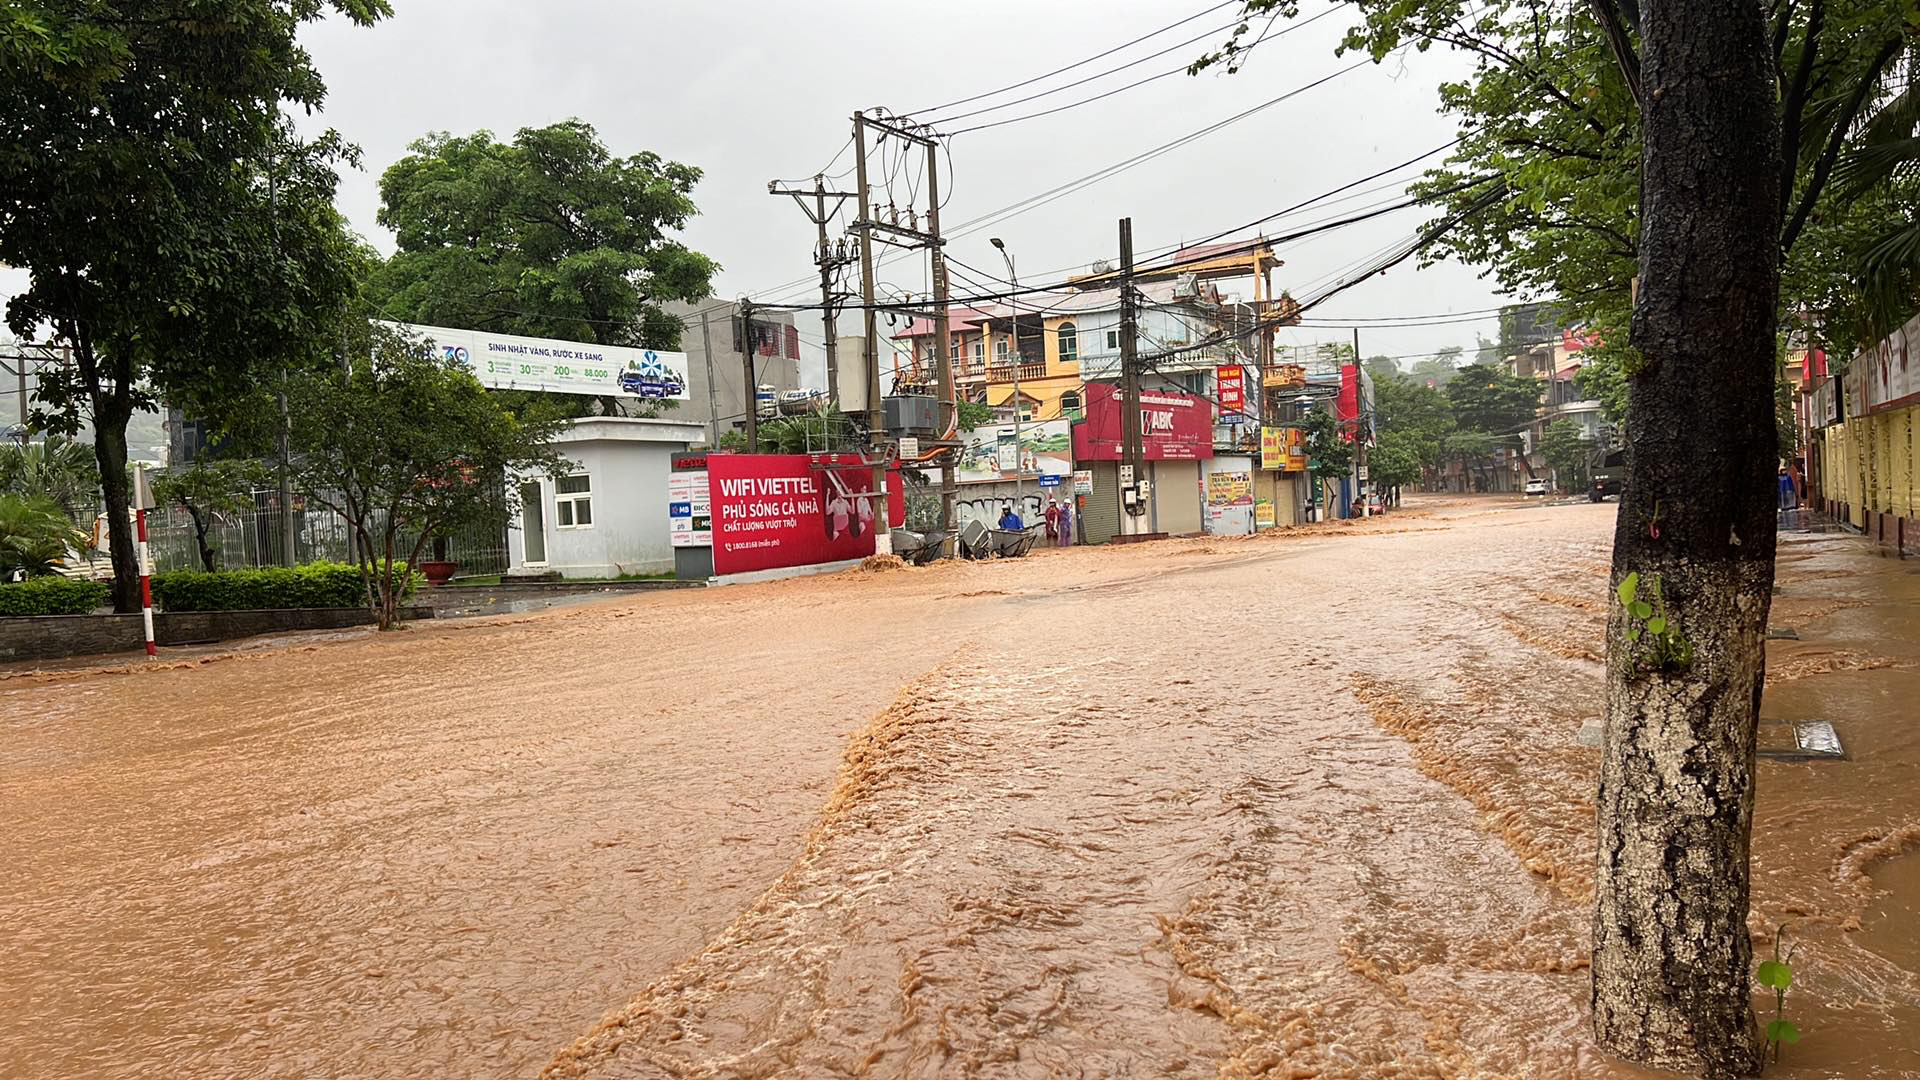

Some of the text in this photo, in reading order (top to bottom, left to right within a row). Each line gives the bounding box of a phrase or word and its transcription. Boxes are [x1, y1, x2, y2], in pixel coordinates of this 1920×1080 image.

[488, 343, 507, 352] SINH
[508, 344, 528, 356] NHẬT
[574, 351, 584, 360] XE
[584, 353, 603, 361] SANG
[487, 361, 495, 373] 3
[519, 364, 531, 375] 30
[554, 365, 570, 376] 200
[584, 368, 608, 378] 88.000
[1152, 410, 1174, 430] ABIC
[720, 477, 818, 496] WIFI VIETTEL
[722, 497, 819, 519] PHỦ SÓNG CẢ NHÀ
[723, 517, 797, 532] CHẤT LƯỢNG VƯỢT TRỘI
